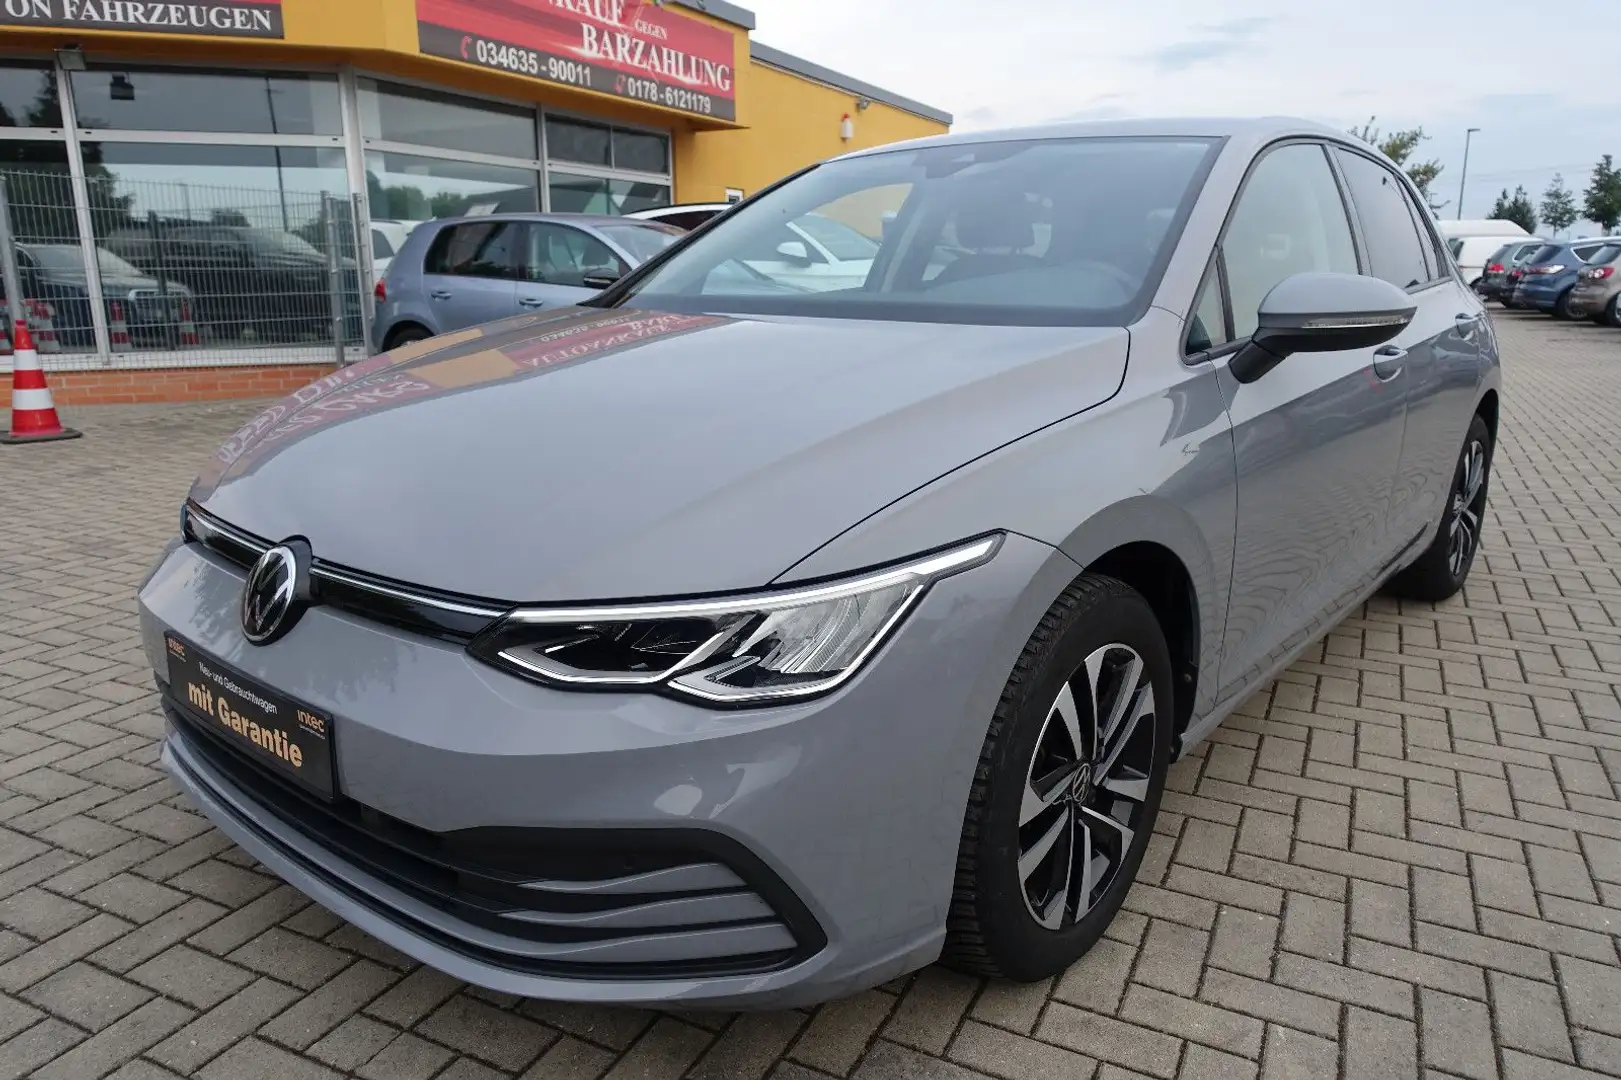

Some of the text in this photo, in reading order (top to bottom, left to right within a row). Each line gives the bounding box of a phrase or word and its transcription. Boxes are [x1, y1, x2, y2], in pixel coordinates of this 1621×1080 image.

[63, 0, 272, 32] FAHRZEUGEN
[635, 18, 669, 40] GEGEN
[580, 22, 731, 92] BARZAHLUNG
[224, 677, 278, 715] Gebrauchtwagen
[188, 682, 303, 767] mit Garantie
